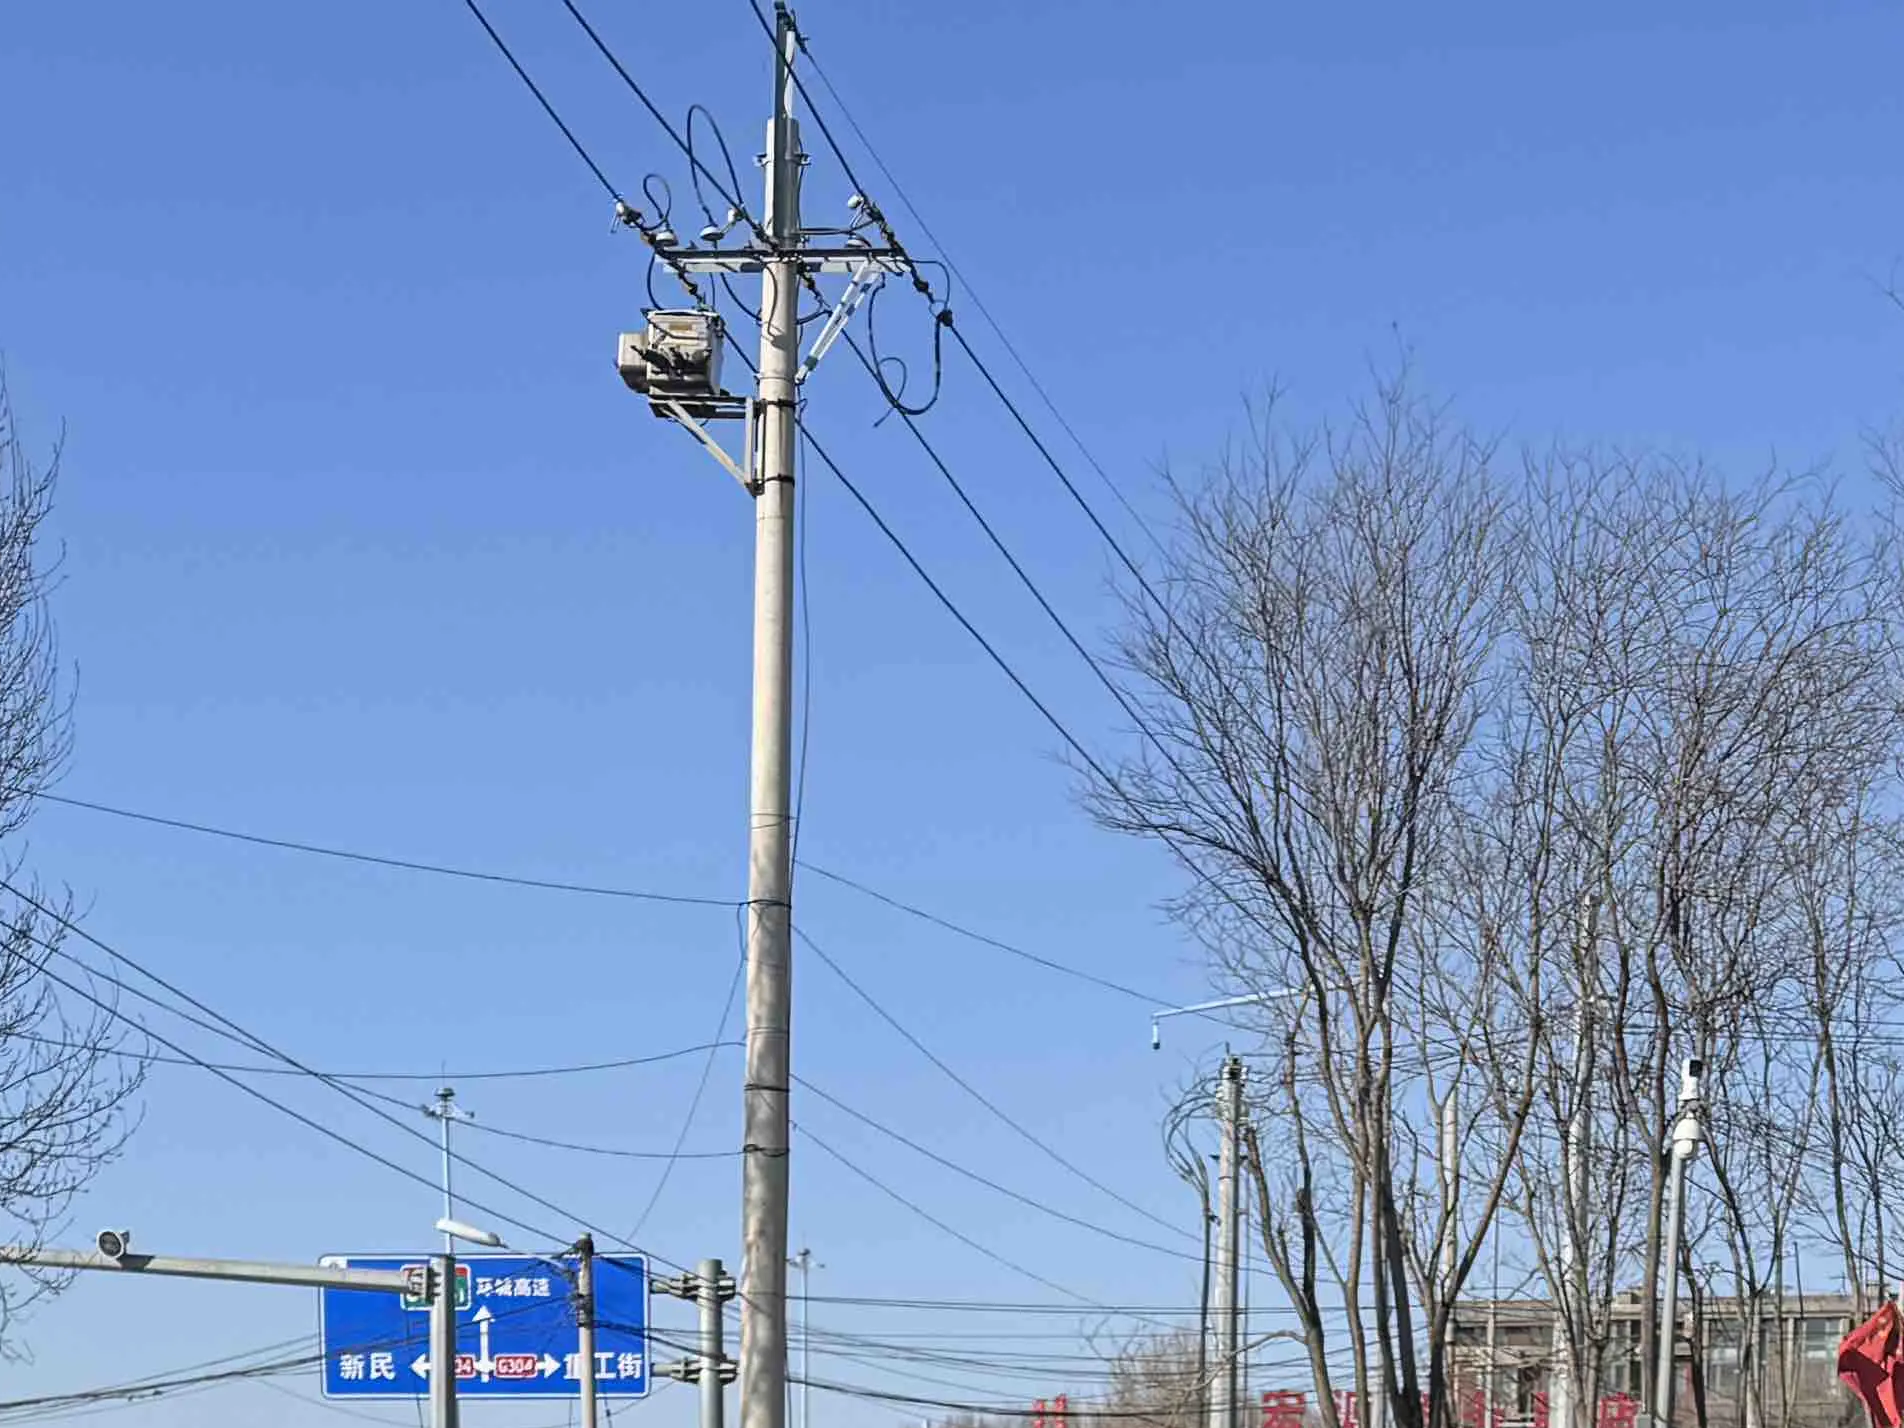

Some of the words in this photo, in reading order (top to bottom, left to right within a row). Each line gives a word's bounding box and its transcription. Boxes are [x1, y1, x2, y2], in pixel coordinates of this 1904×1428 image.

[475, 1278, 551, 1297] 环城高速
[339, 1352, 395, 1380] 新民
[497, 1357, 536, 1376] G304
